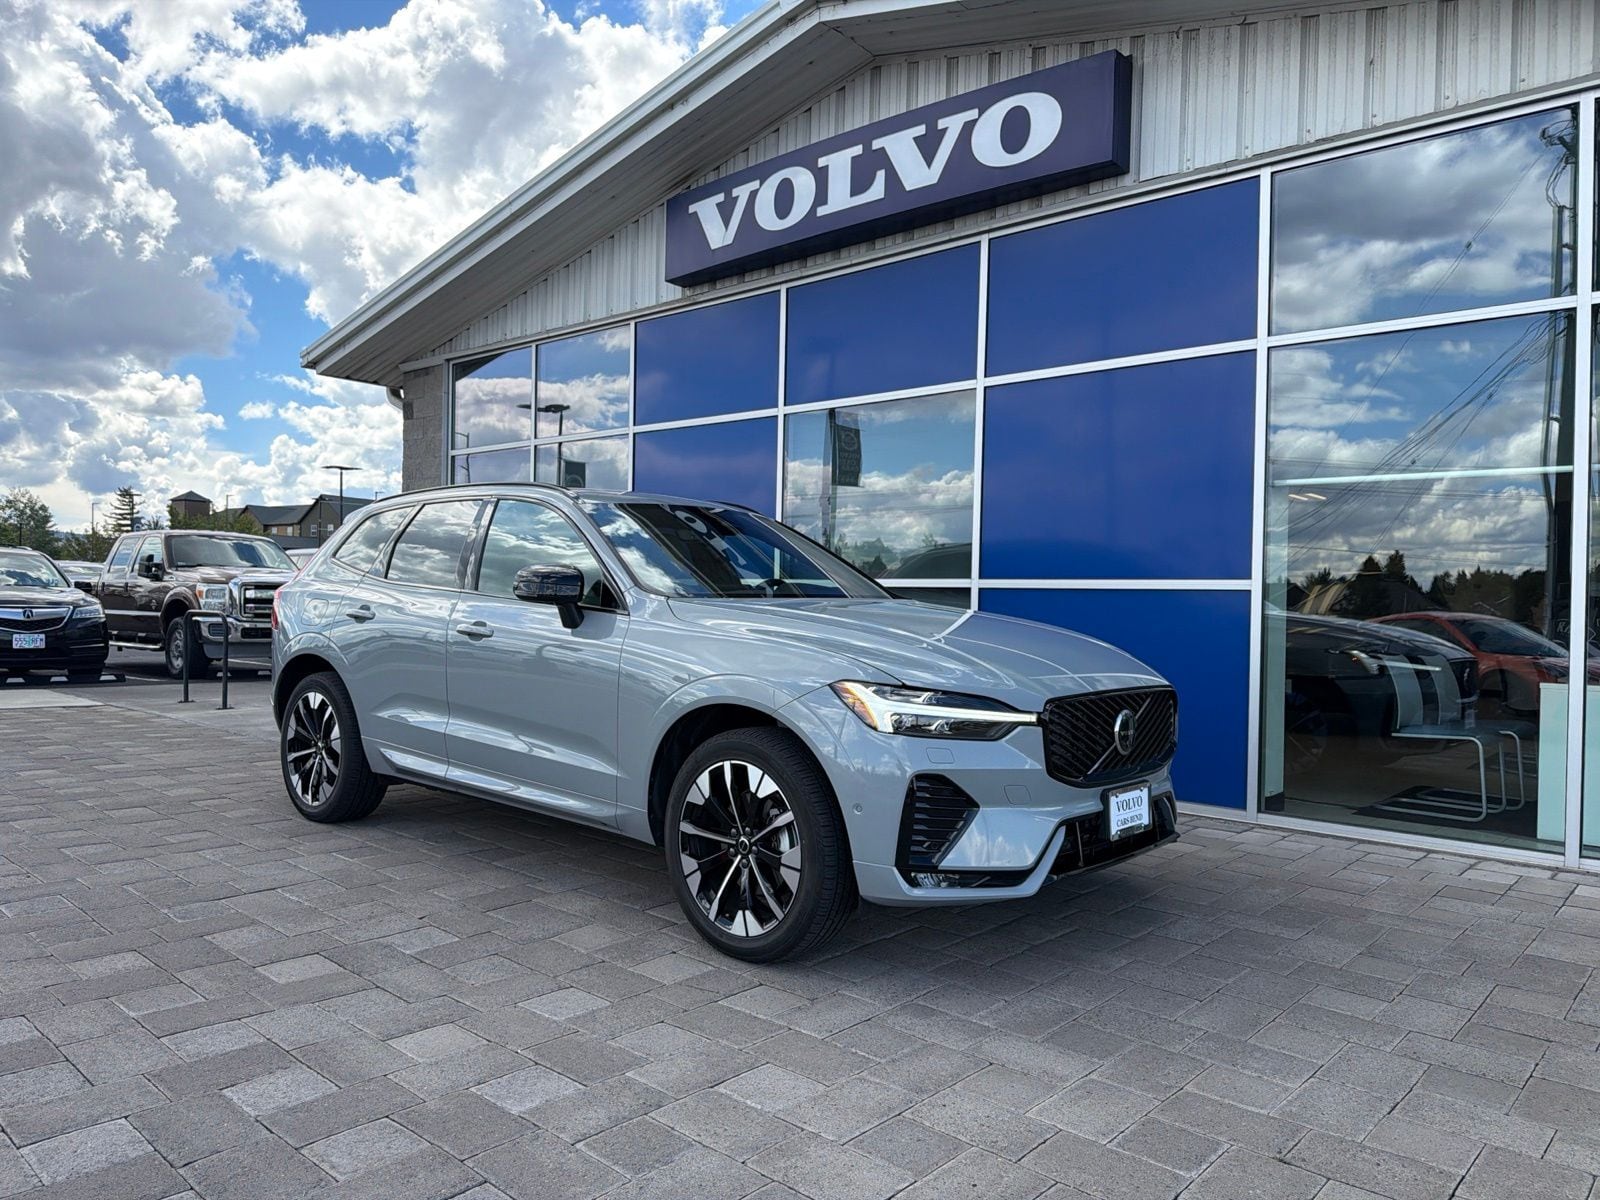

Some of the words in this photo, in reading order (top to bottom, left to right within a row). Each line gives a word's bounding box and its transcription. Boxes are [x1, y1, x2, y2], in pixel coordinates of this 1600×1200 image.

[689, 91, 1062, 250] VOLVO
[1116, 795, 1143, 812] VOLVO
[1116, 817, 1130, 827] CARS
